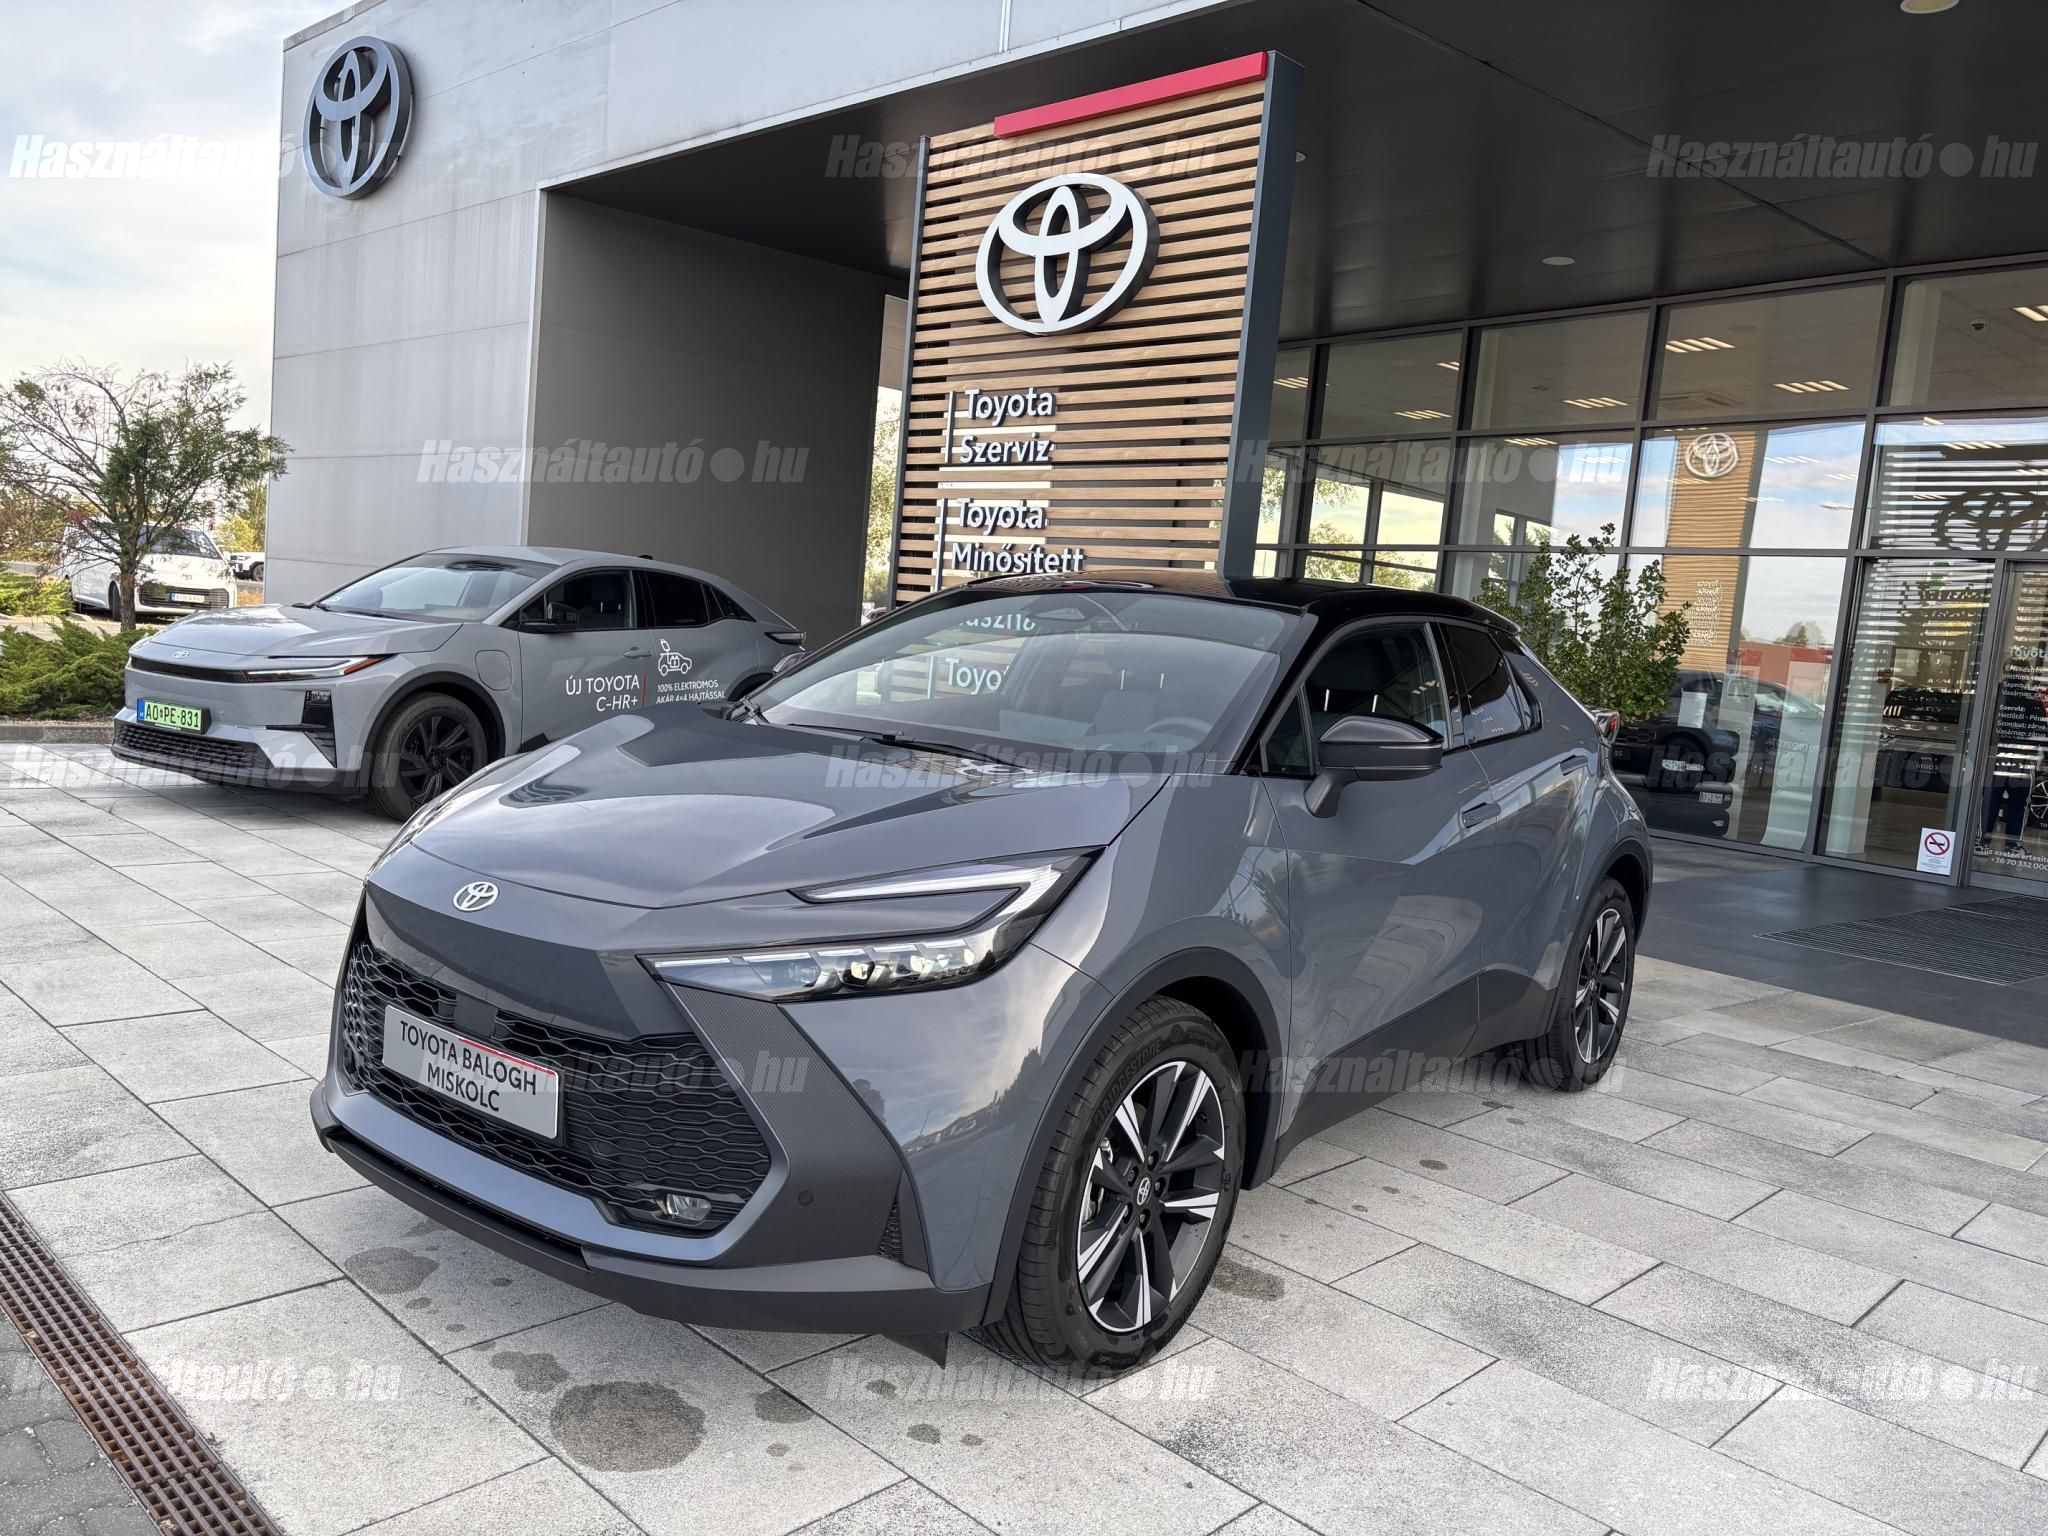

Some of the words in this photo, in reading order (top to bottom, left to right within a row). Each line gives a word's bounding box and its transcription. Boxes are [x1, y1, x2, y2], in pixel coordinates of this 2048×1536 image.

[965, 387, 1054, 427] Toyota
[960, 432, 1051, 464] Szerviz
[957, 498, 1045, 536] Toyota
[952, 542, 1084, 574] Minősített
[566, 675, 582, 696] ÚJ
[586, 675, 640, 694] TOYOTA
[656, 693, 674, 704] AKÁR
[688, 690, 726, 702] HAJTÁSSAL
[657, 681, 673, 693] 100%
[674, 680, 719, 692] ELEKTROMOS
[596, 694, 638, 712] C-HR+
[400, 1021, 458, 1065] TOYOTA
[462, 1048, 536, 1095] BALOGH
[428, 1062, 500, 1112] MISKOLC
